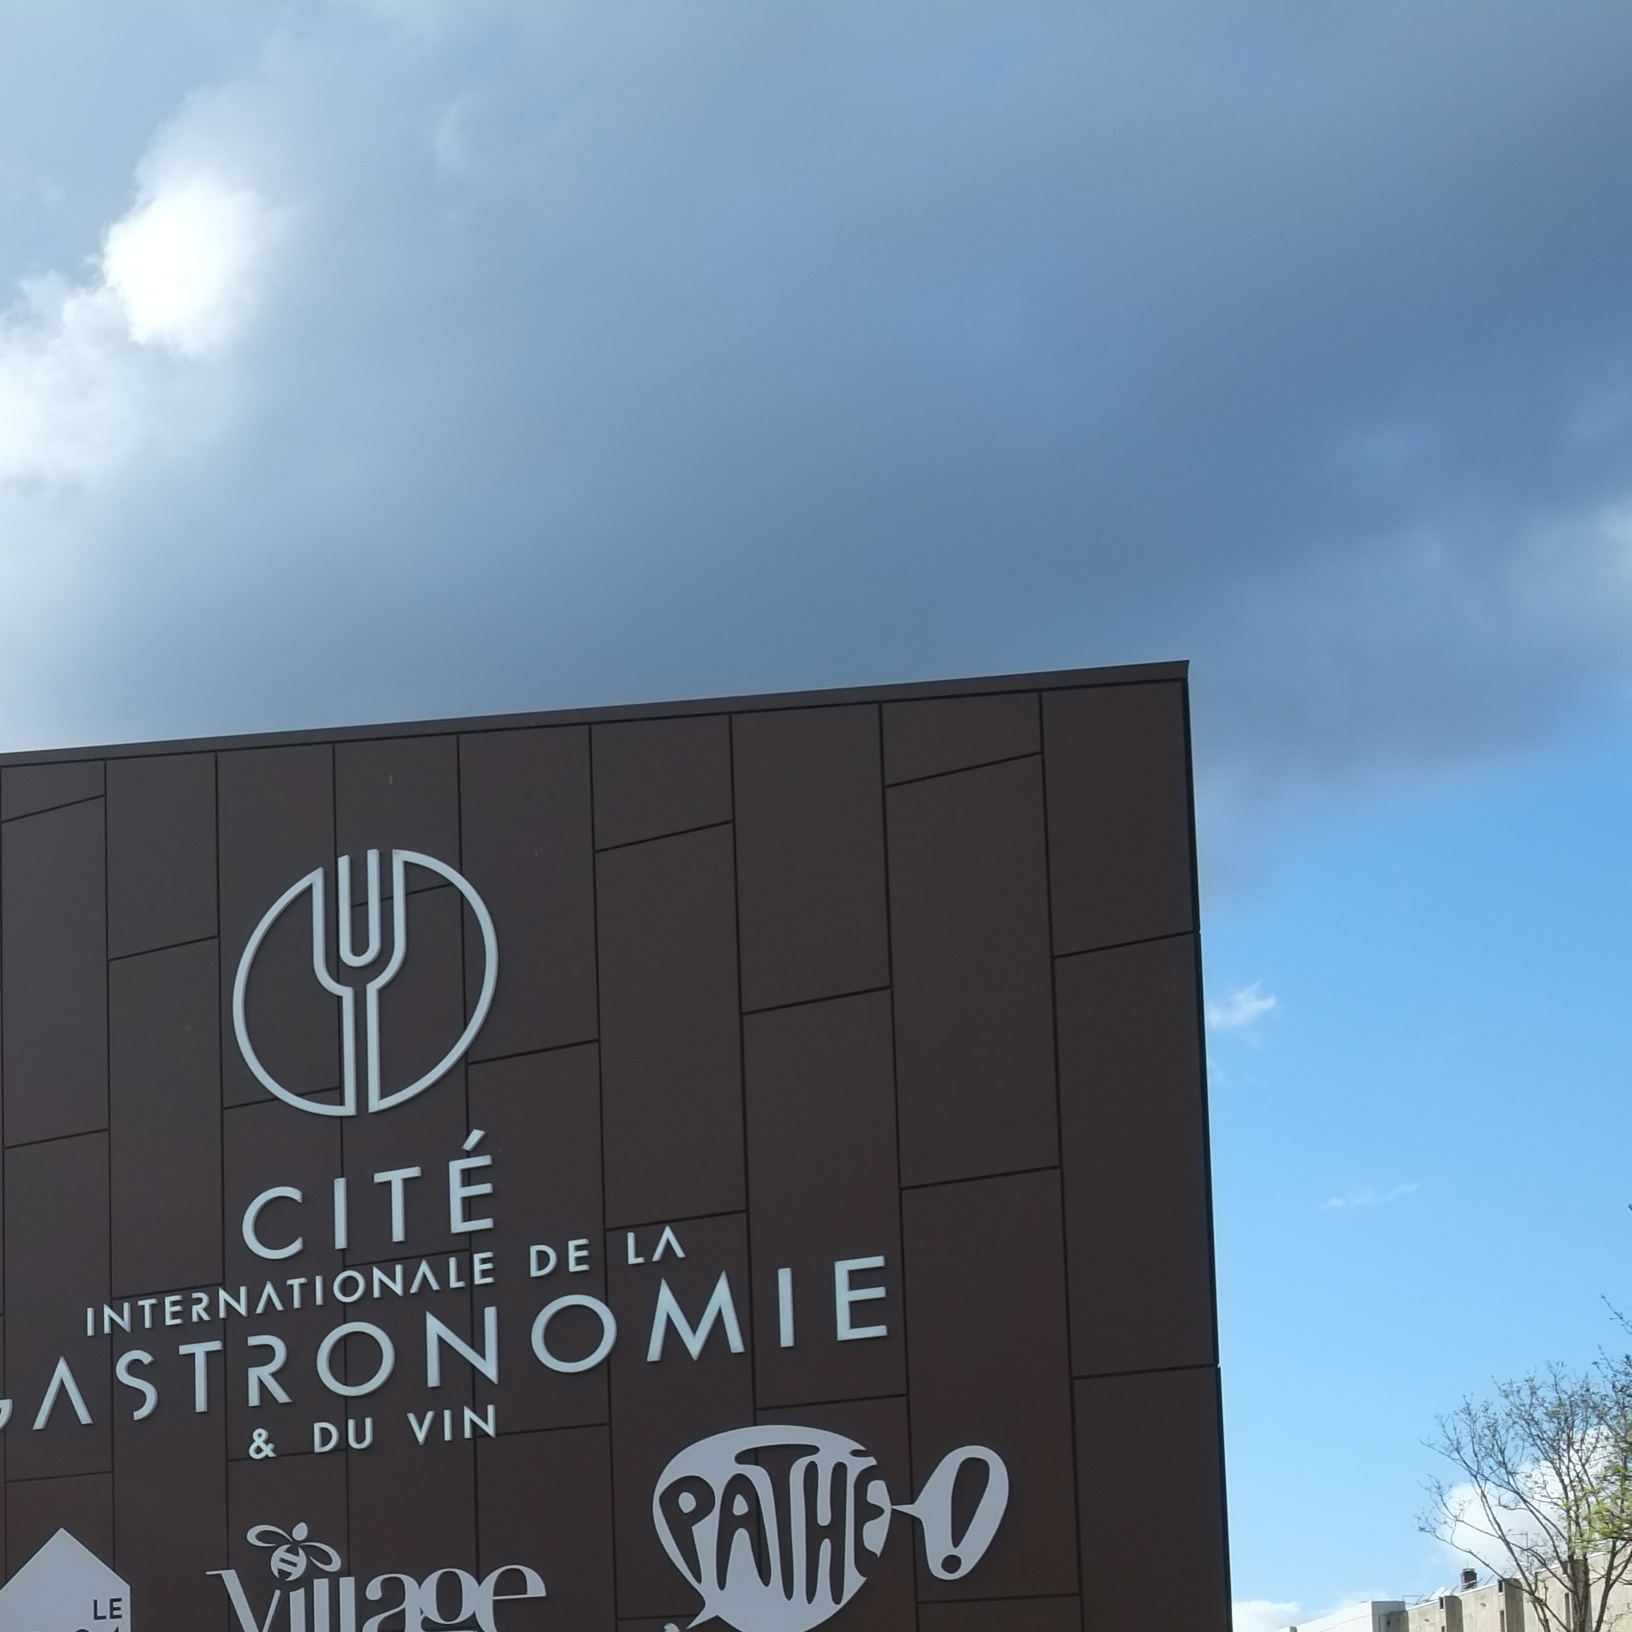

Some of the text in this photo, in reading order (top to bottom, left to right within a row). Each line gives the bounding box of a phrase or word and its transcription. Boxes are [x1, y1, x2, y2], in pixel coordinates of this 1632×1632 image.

[242, 1129, 494, 1260] CITÉ
[86, 1225, 686, 1337] INTERNATIONALE DE LA
[248, 1404, 496, 1460] & DU VIN
[92, 1598, 124, 1621] LE
